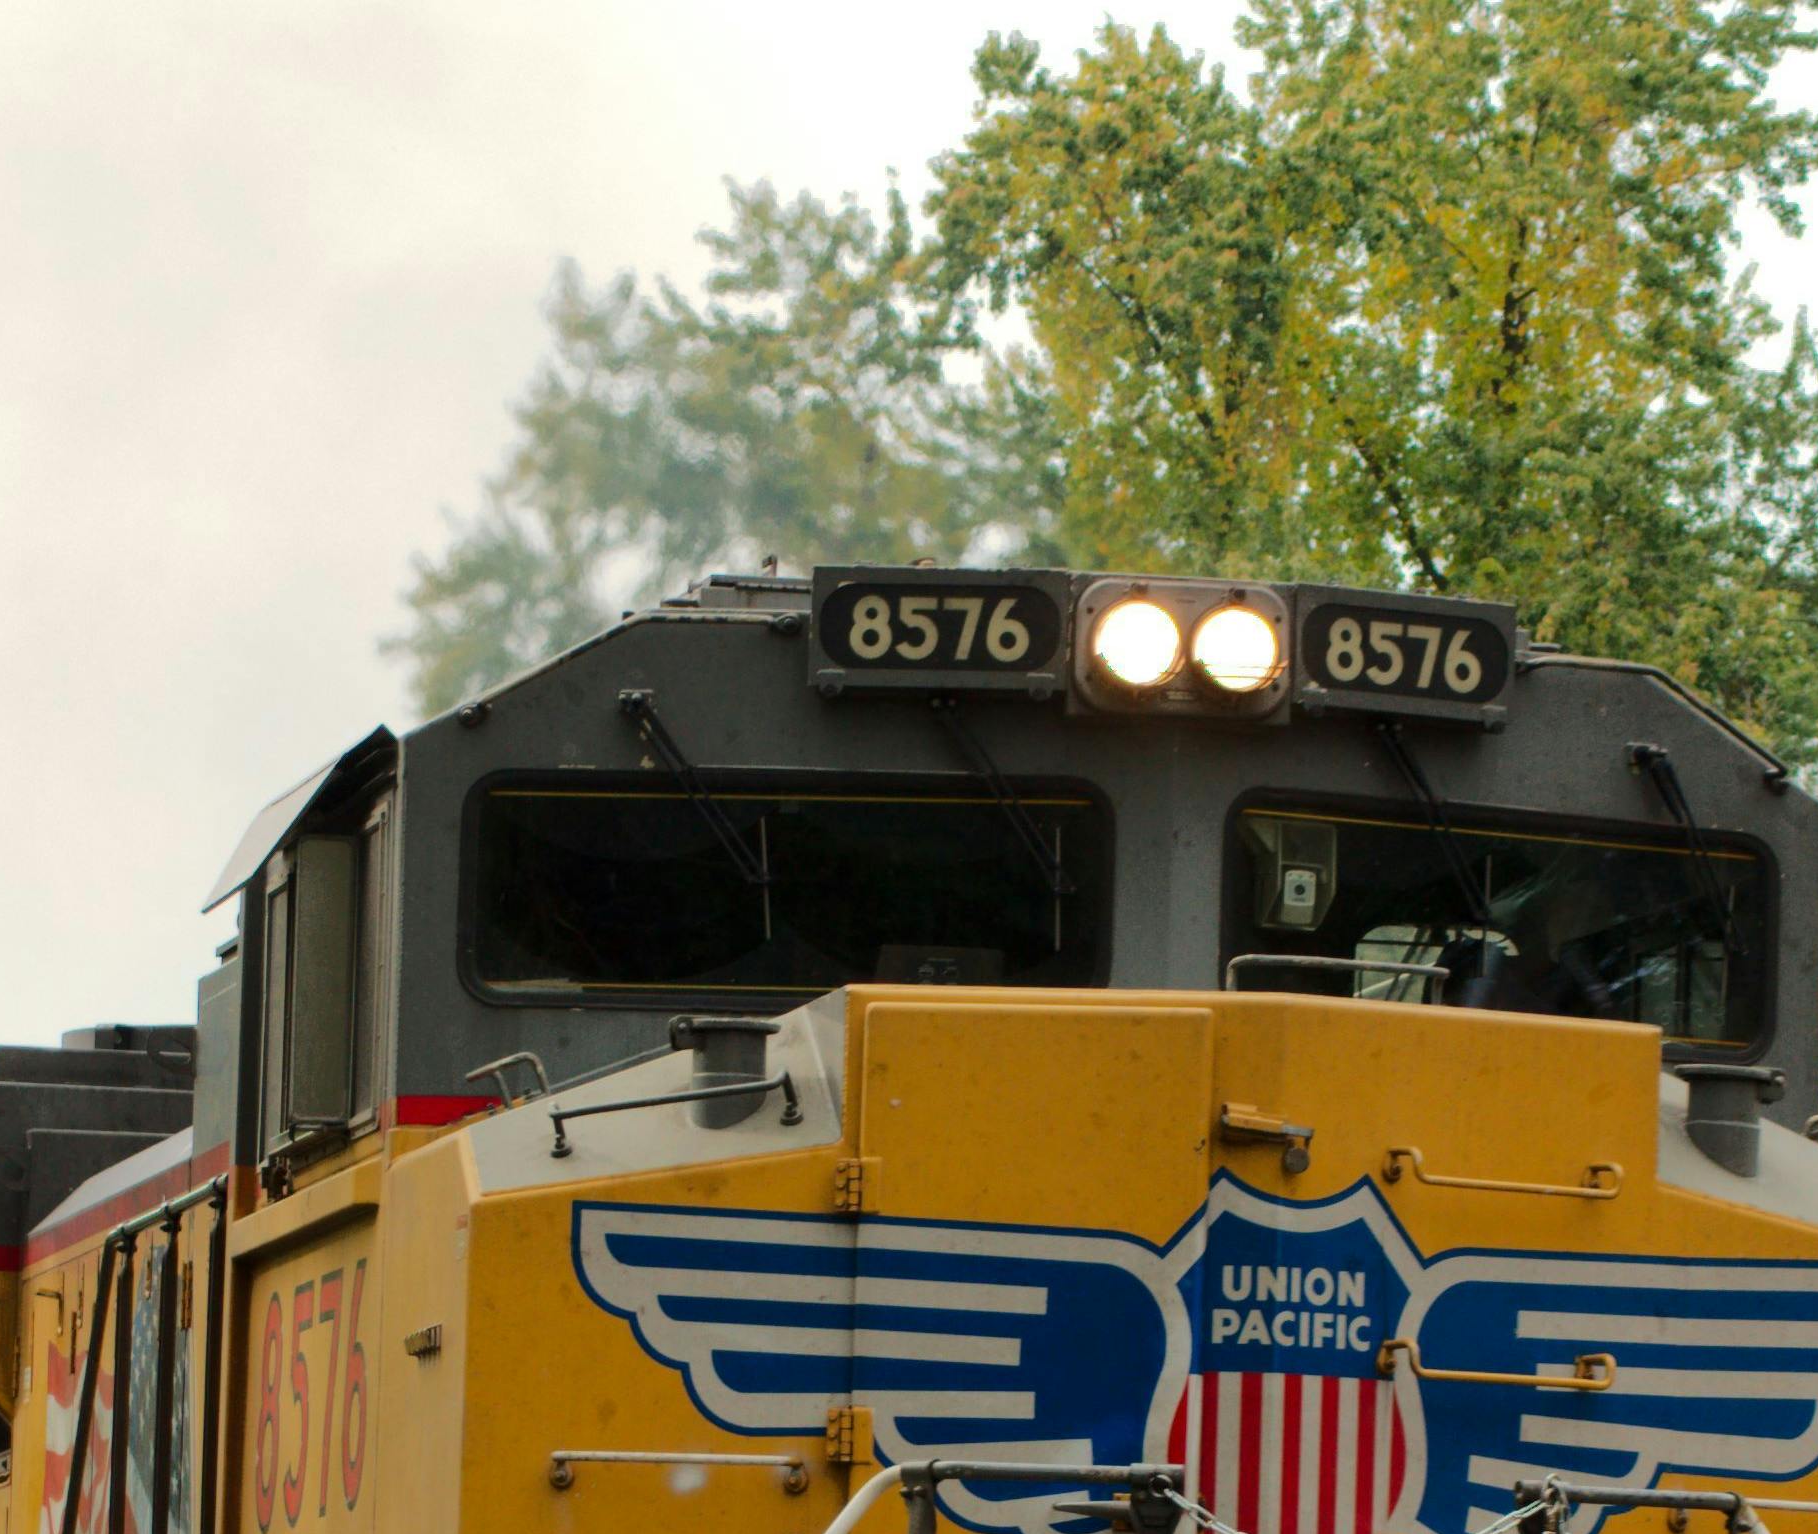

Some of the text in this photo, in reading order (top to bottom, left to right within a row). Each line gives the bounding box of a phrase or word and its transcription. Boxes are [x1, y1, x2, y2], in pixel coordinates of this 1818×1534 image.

[849, 594, 1030, 663] 8576
[1325, 617, 1482, 694] 8576
[1222, 1264, 1366, 1308] UNION
[1211, 1307, 1371, 1352] PACIFIC
